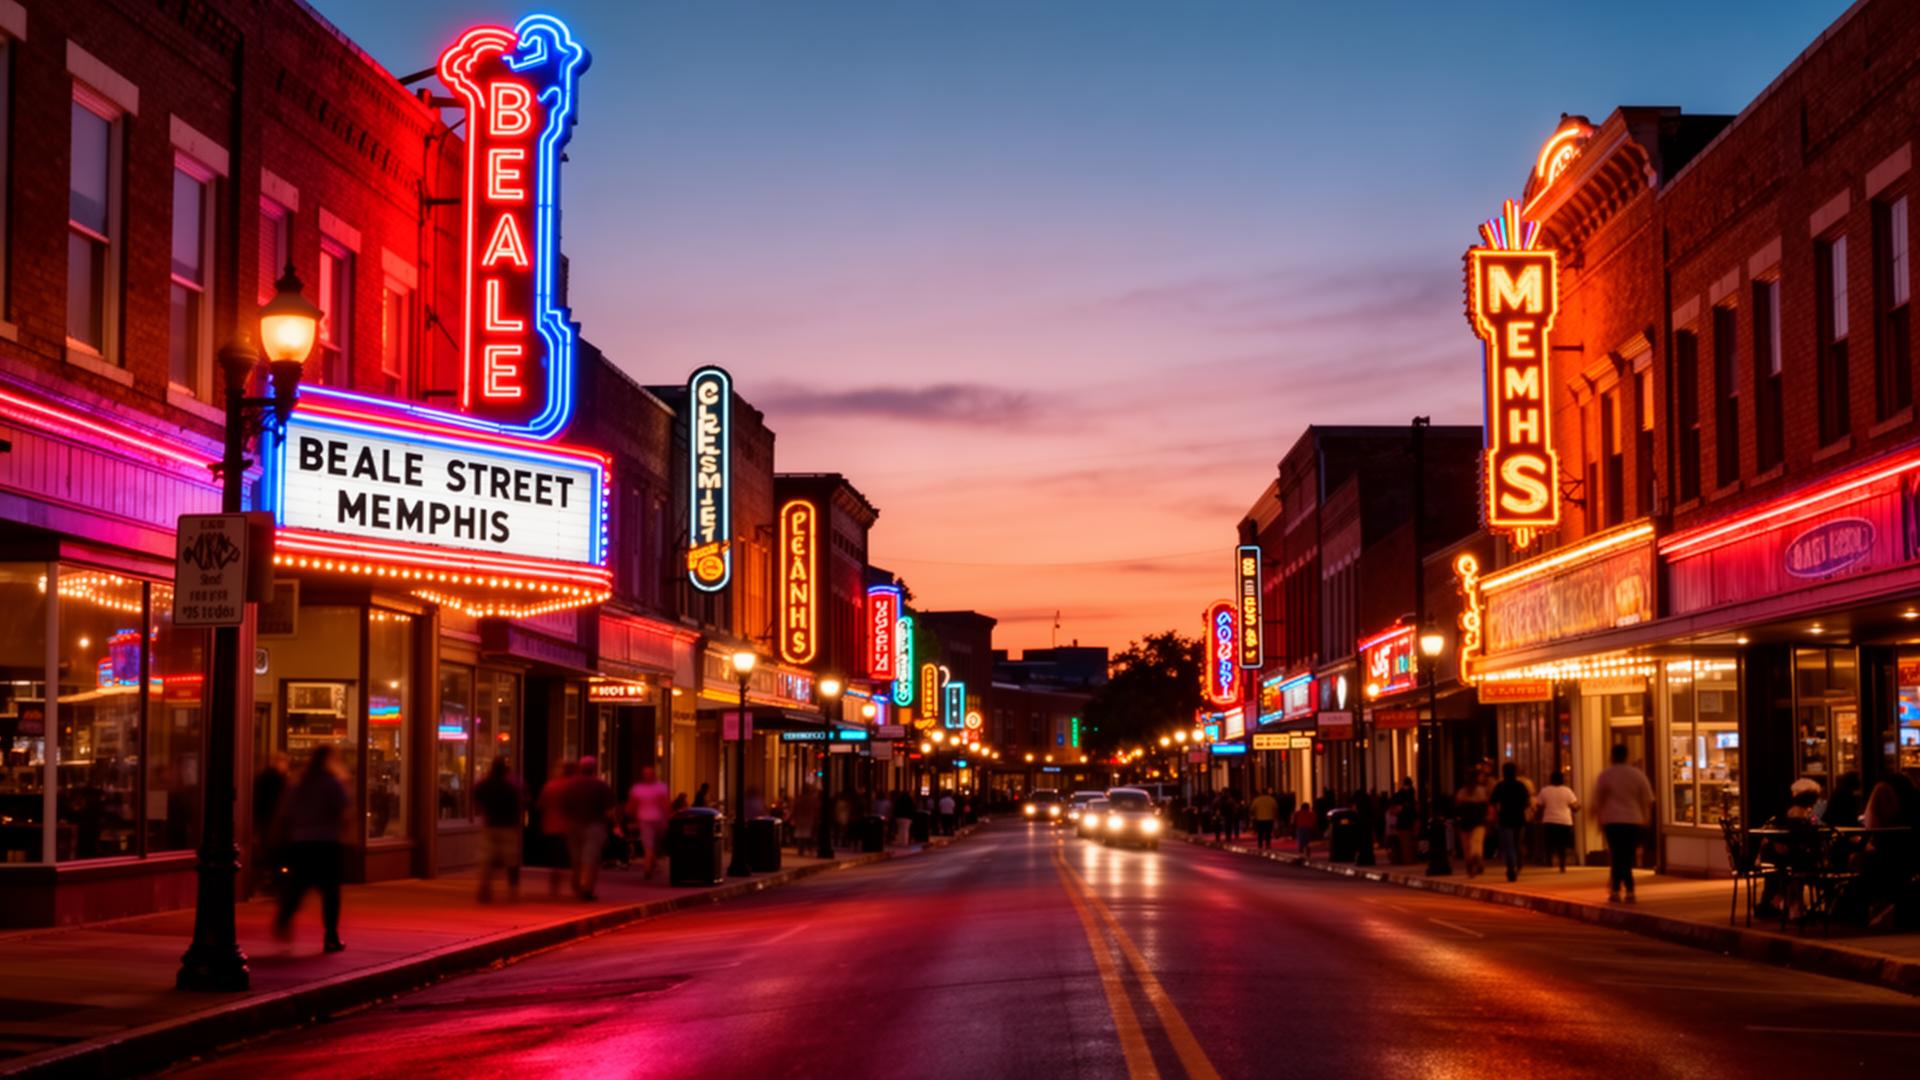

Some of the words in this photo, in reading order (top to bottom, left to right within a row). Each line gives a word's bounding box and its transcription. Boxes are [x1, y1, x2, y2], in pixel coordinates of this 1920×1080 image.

[482, 82, 531, 397] BEALE
[1487, 265, 1549, 513] MEMHS
[299, 436, 423, 487] BEALE
[446, 459, 574, 508] STREET
[337, 490, 510, 543] MEMPHIS
